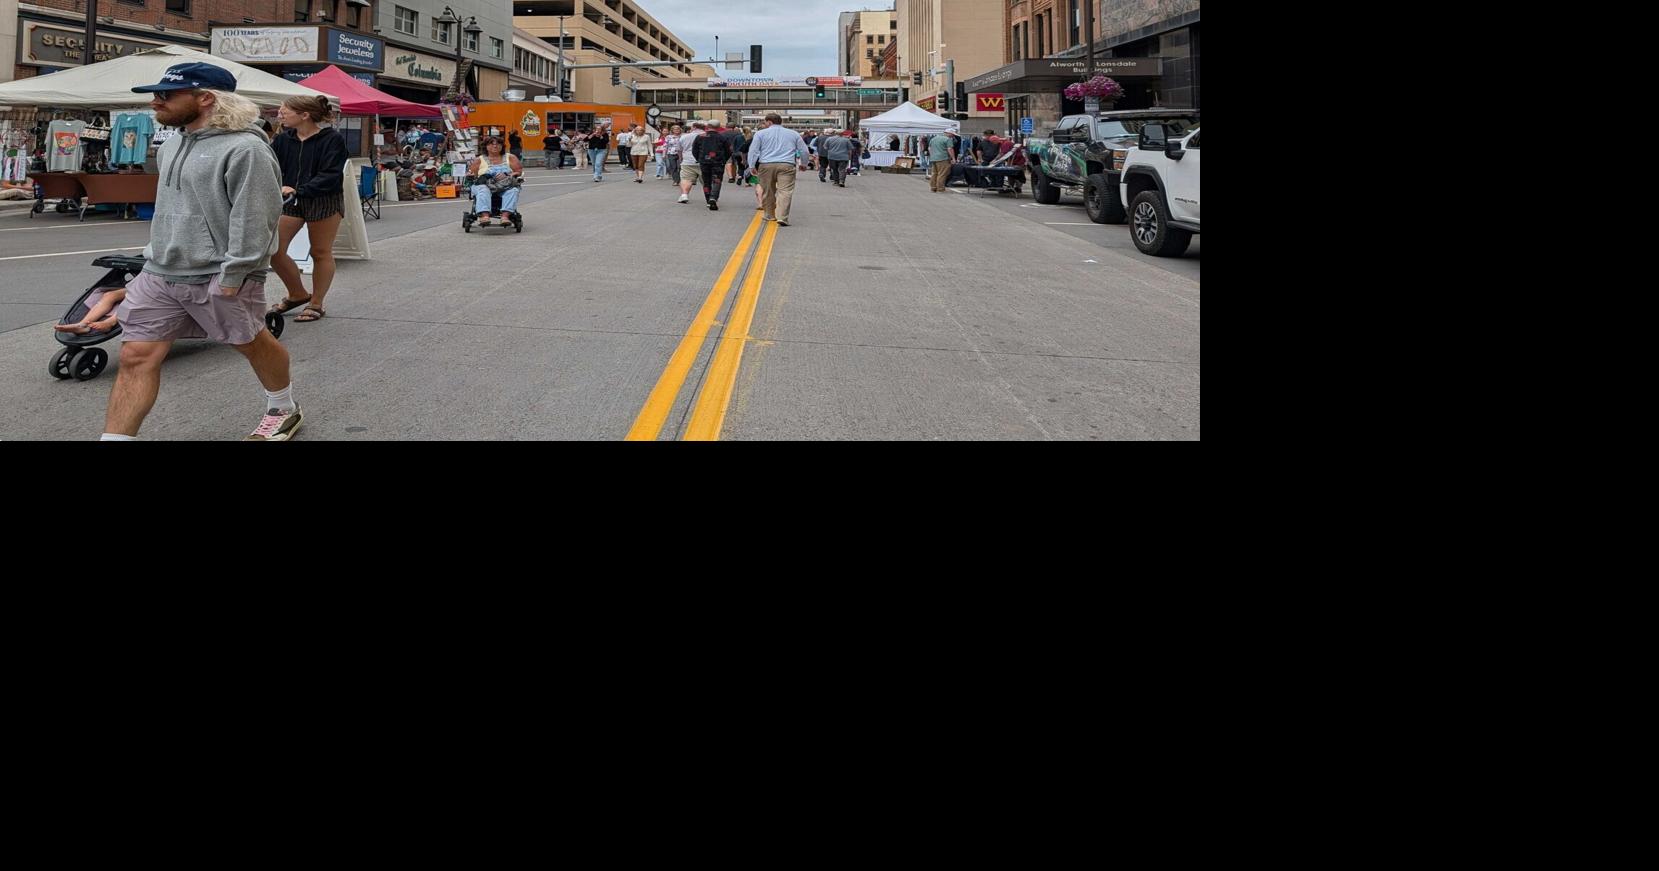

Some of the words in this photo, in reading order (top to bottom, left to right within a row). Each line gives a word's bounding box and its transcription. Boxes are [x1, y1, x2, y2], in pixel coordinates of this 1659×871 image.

[223, 29, 240, 37] 100
[41, 33, 124, 55] SECUITY
[339, 33, 375, 51] Security
[63, 51, 81, 60] THE
[337, 44, 375, 59] Jewelers
[407, 62, 442, 82] Columbia
